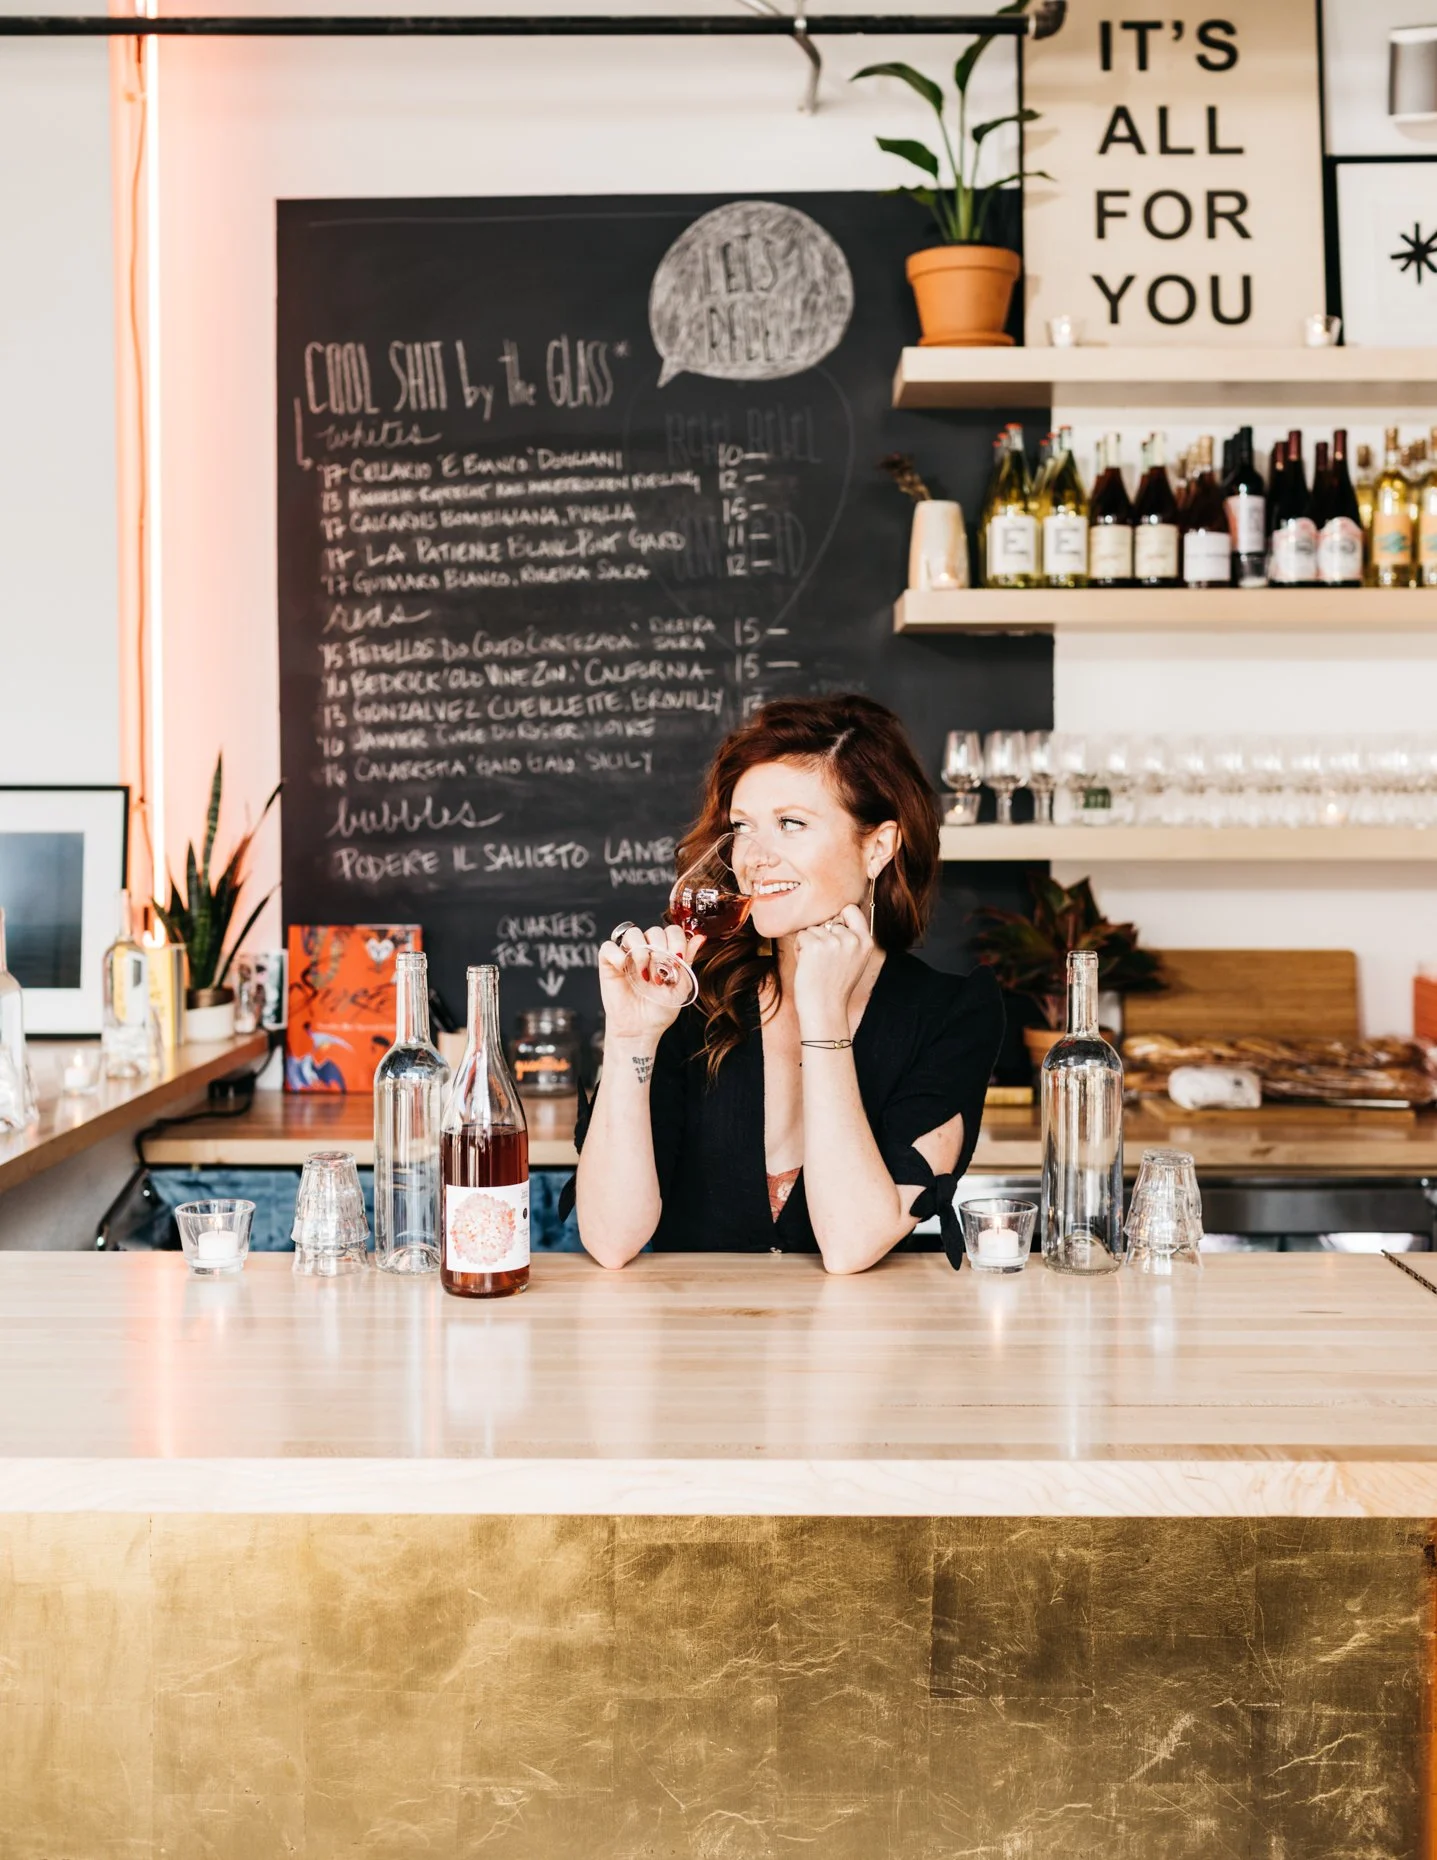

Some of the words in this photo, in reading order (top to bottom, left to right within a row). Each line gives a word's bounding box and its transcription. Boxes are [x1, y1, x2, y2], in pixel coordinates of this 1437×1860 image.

[1099, 18, 1240, 73] IT'S
[1098, 105, 1245, 155] ALL
[1095, 189, 1252, 241] FOR
[1091, 274, 1253, 326] YOU
[304, 340, 381, 416] COOL
[389, 340, 448, 412] SHIT
[455, 339, 495, 422] by
[366, 543, 406, 567] LA
[326, 795, 504, 838] bubbles
[334, 847, 439, 884] PODERE
[452, 845, 478, 872] IL
[604, 836, 675, 864] LAMB
[609, 866, 678, 889] MODEN
